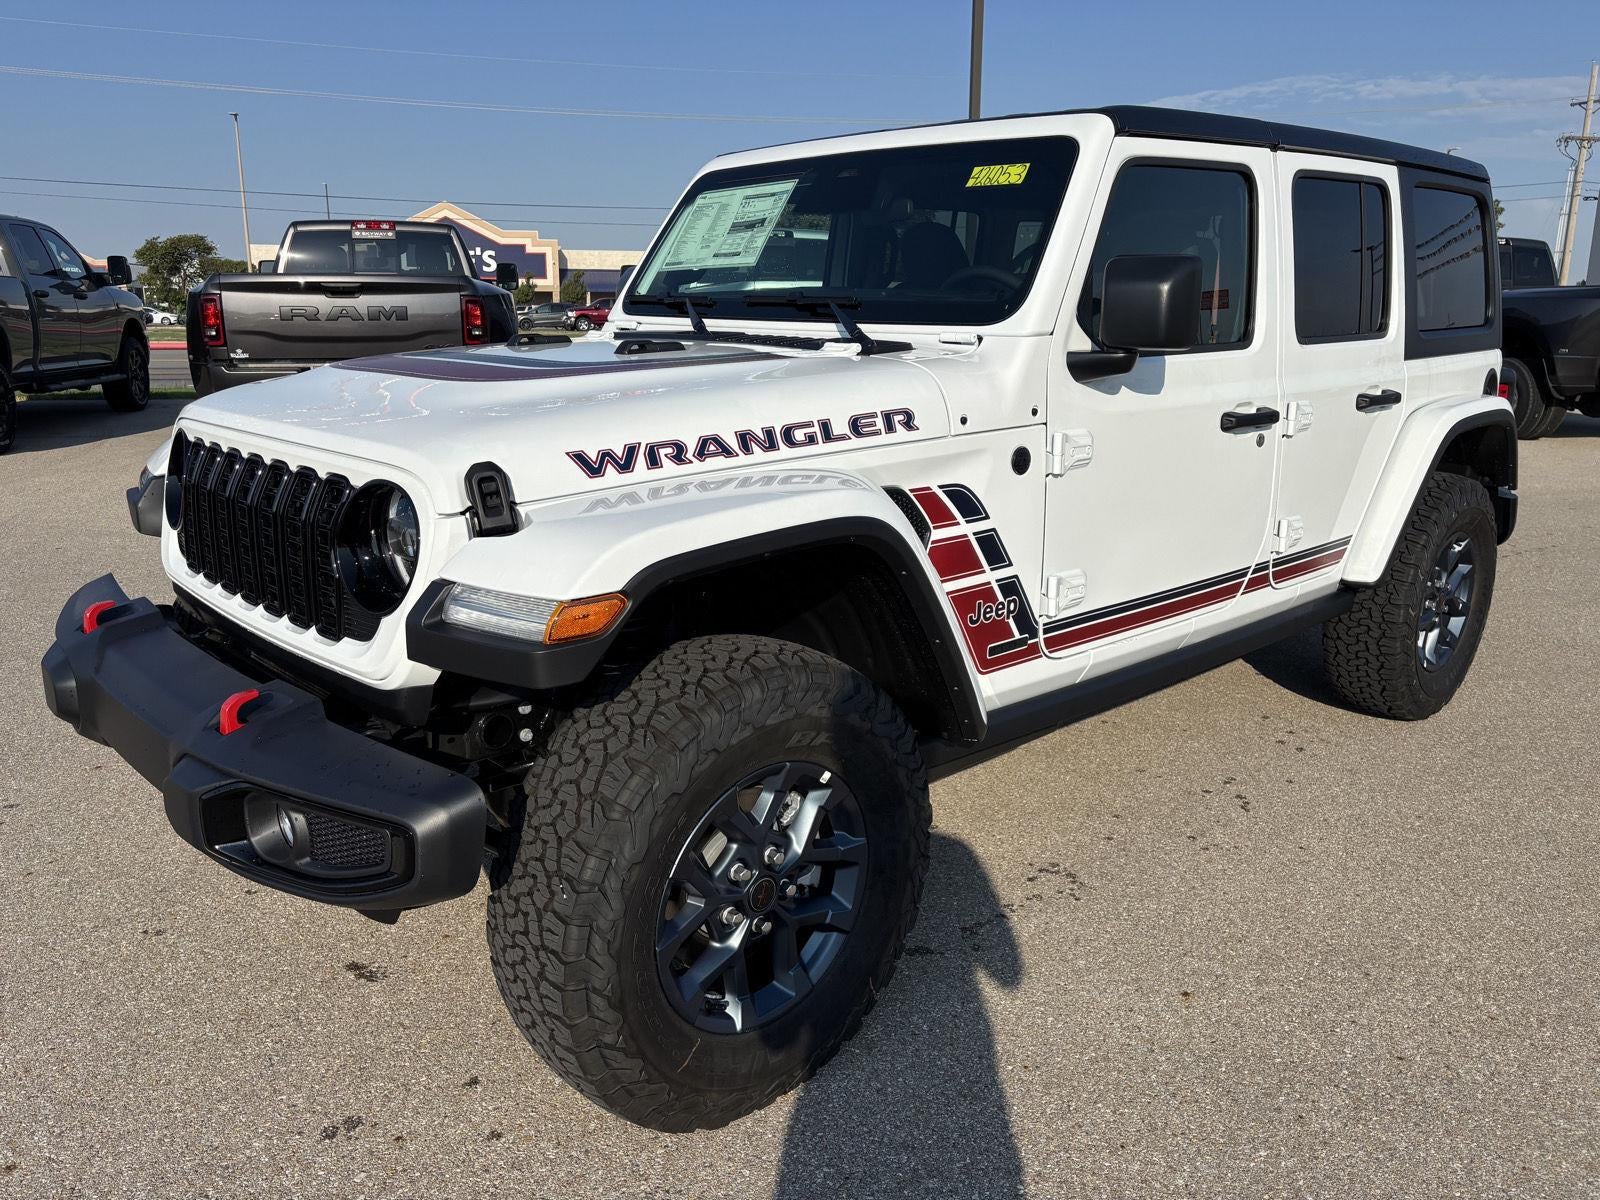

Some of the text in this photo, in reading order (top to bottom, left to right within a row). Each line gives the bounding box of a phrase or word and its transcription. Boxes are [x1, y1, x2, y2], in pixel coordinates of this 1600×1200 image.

[279, 305, 409, 322] RAM
[565, 407, 919, 478] WRANGLER
[967, 596, 1019, 628] Jeep
